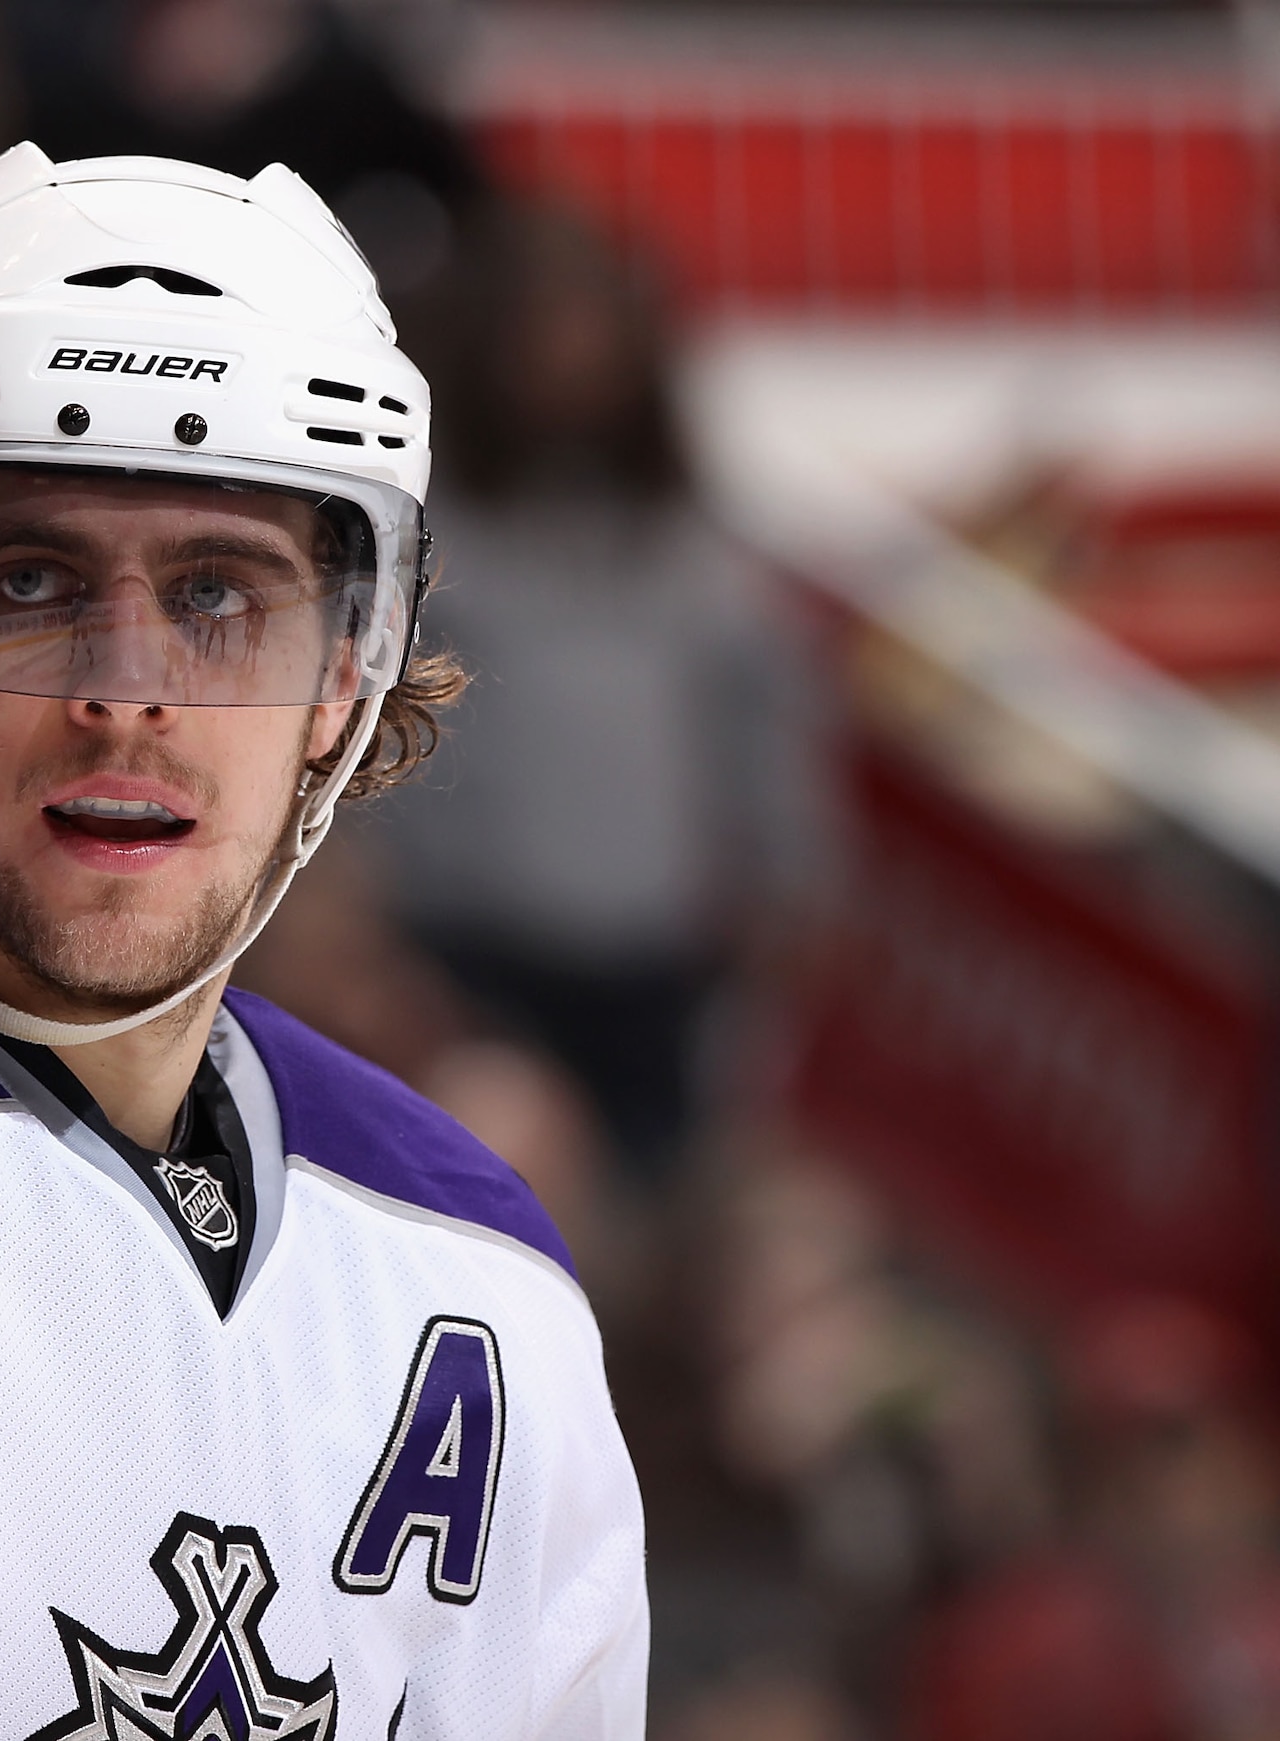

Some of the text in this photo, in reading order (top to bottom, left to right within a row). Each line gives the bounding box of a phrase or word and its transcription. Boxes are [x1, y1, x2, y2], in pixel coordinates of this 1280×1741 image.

[48, 347, 229, 384] BAUER
[185, 1185, 219, 1225] NHL
[333, 1314, 505, 1606] A
